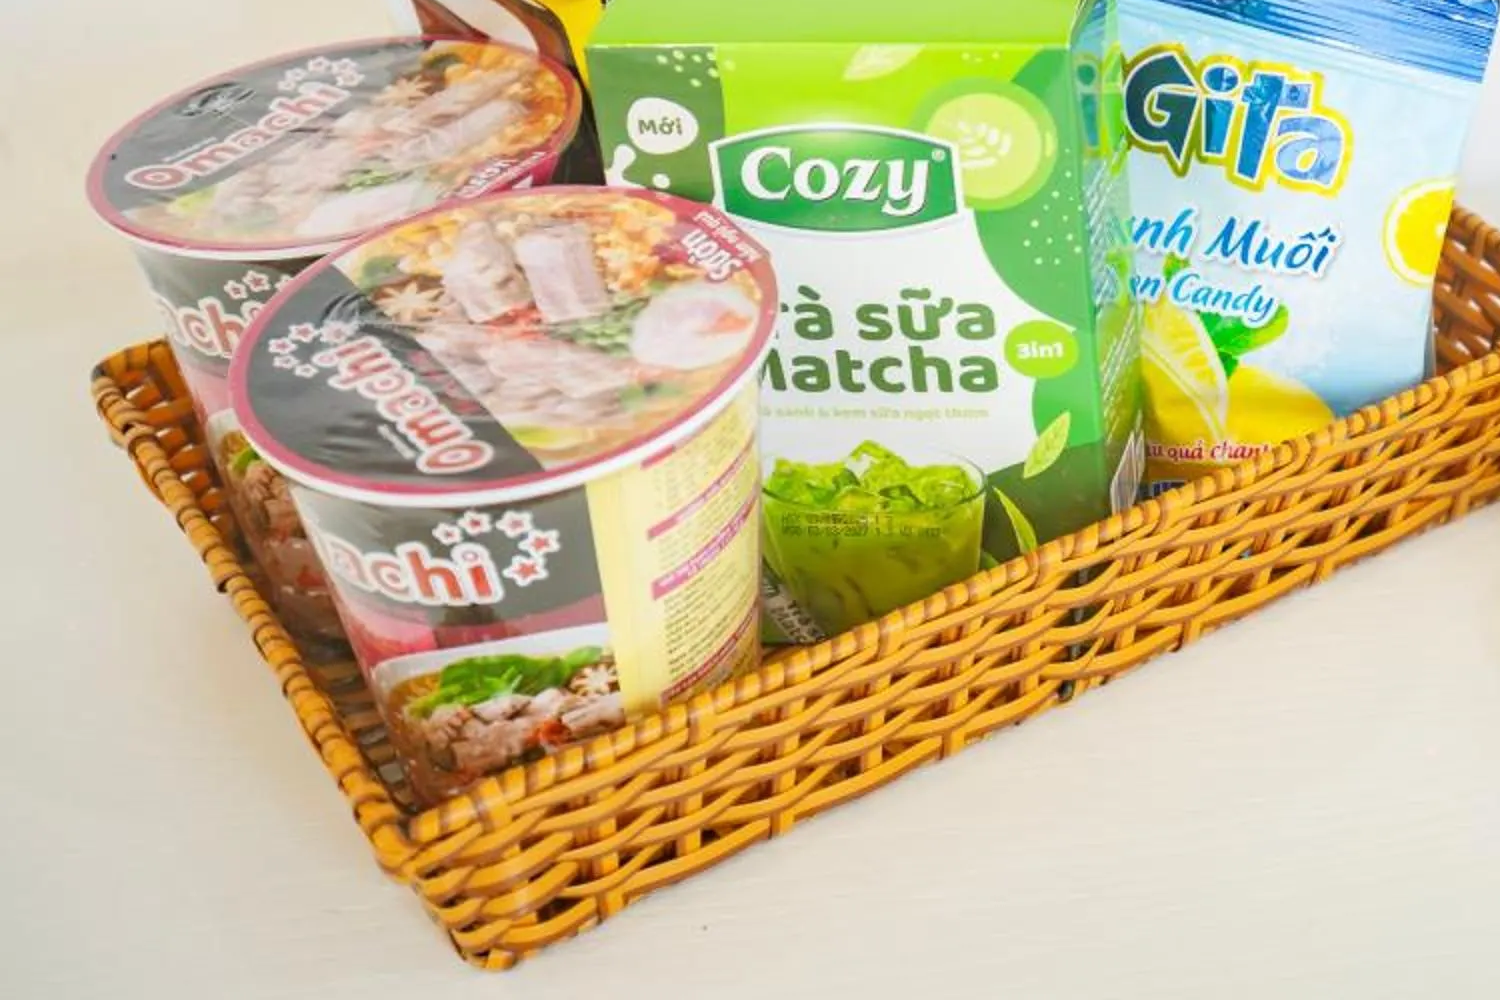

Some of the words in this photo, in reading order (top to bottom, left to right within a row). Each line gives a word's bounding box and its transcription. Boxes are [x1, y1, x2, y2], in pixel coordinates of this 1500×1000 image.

[125, 81, 351, 189] Omachi
[638, 115, 684, 136] Mới
[1124, 51, 1344, 187] Gita
[741, 147, 930, 216] Cozy
[1204, 215, 1338, 273] Muối
[855, 287, 996, 341] sữa
[1171, 272, 1274, 323] Candy
[1015, 340, 1064, 359] 3in1
[312, 335, 494, 474] Omachi
